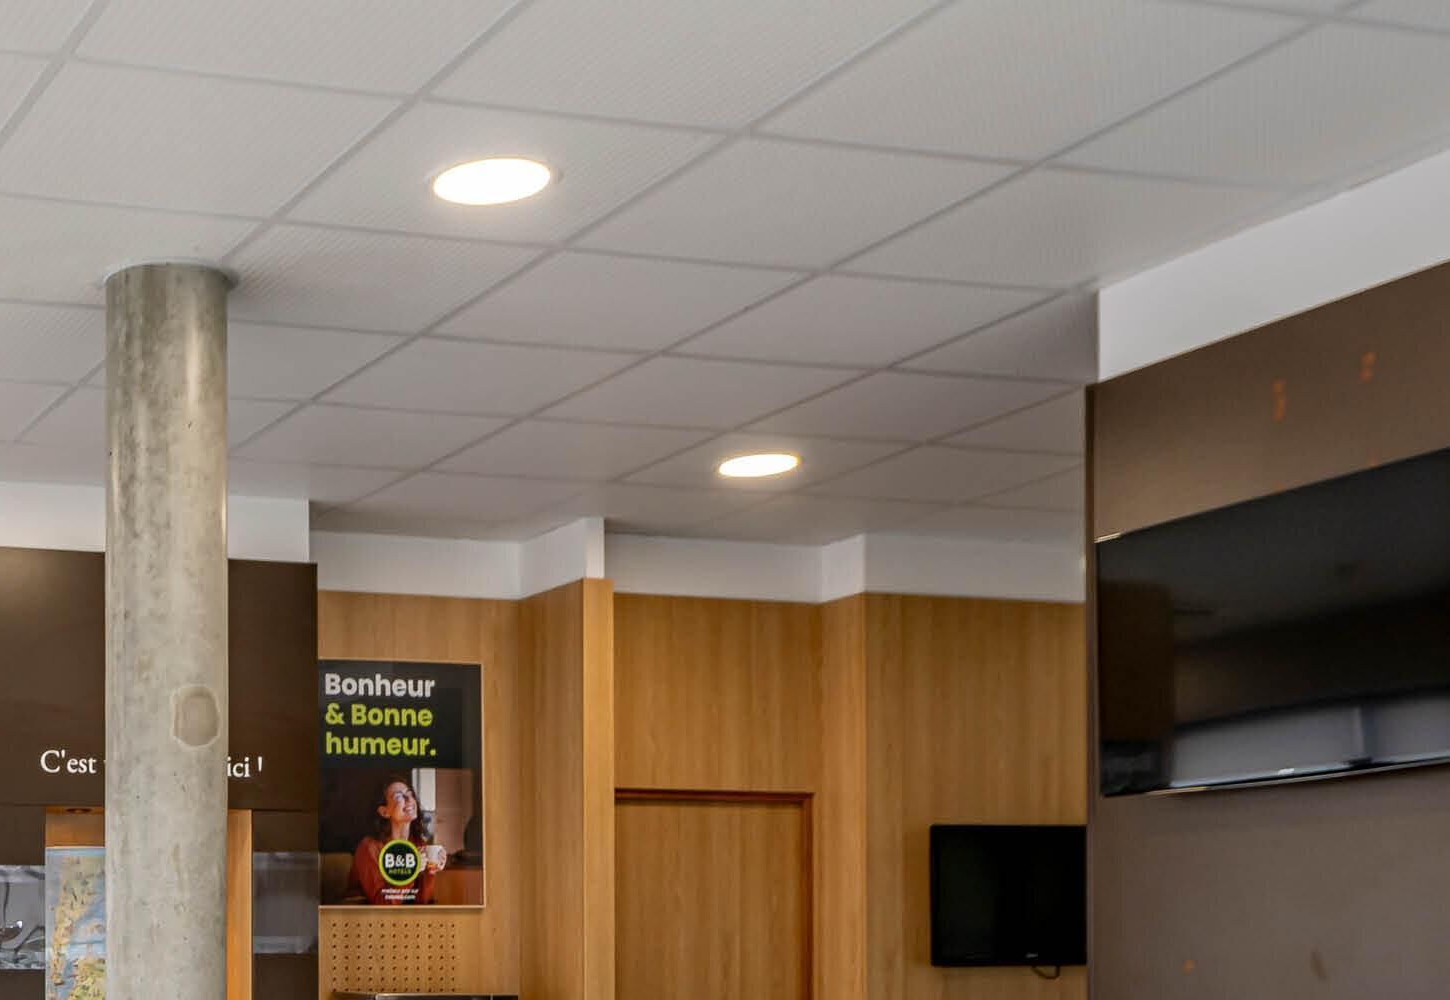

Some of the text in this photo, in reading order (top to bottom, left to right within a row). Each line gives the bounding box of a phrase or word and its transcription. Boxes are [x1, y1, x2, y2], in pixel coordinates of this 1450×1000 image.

[324, 673, 436, 698] Bonheur
[325, 702, 433, 727] & Bonne
[325, 732, 437, 756] humeur.
[40, 749, 97, 774] C'est
[226, 756, 251, 778] ici
[384, 853, 416, 869] B&B
